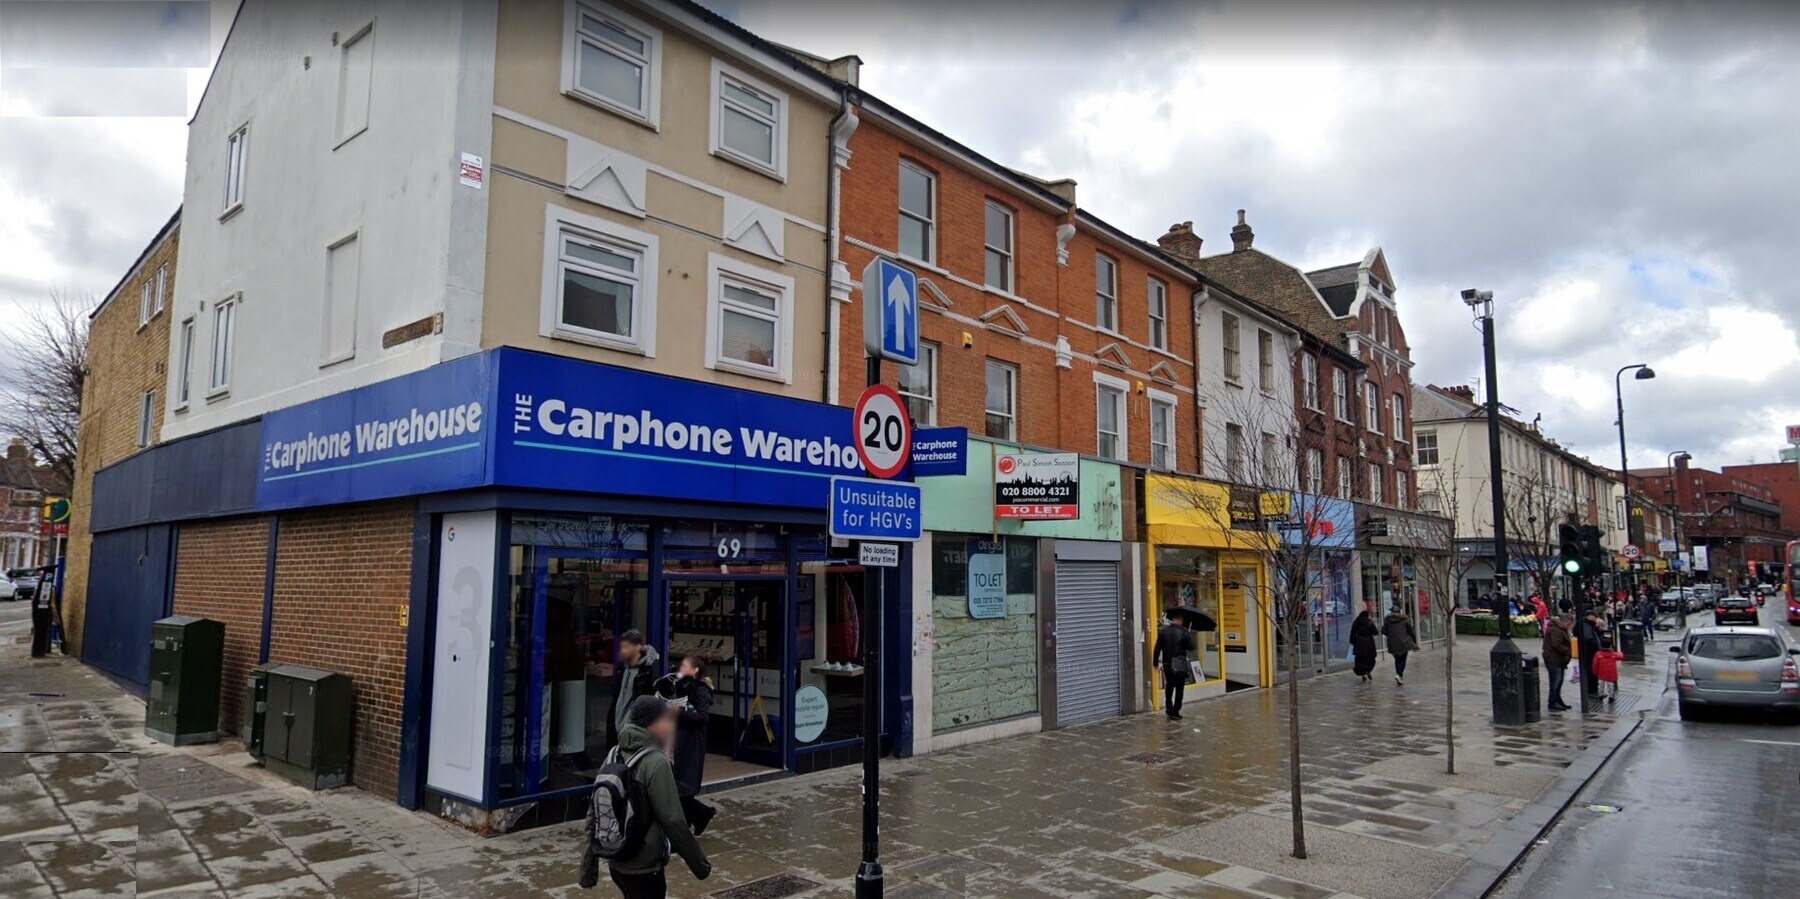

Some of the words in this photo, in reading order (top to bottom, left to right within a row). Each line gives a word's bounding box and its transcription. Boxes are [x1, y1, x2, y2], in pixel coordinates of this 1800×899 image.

[264, 443, 272, 473] THE
[272, 430, 351, 471] Carphone
[355, 402, 482, 454] Warehouse
[514, 393, 532, 433] THE
[538, 399, 733, 455] Carphone
[740, 427, 867, 471] Wareho
[864, 410, 901, 452] 20
[917, 440, 958, 451] Carphone
[912, 452, 958, 461] Warehouse
[1017, 459, 1030, 467] Paul
[1032, 459, 1052, 467] Simon
[840, 486, 916, 509] Unsuitable
[1002, 487, 1020, 496] 020
[1022, 487, 1046, 496] 8800
[1048, 486, 1070, 496] 4321
[1010, 506, 1030, 514] TO
[1034, 506, 1062, 514] LET
[843, 509, 864, 527] for
[870, 511, 912, 530] HGV's
[717, 538, 741, 558] 69
[863, 546, 873, 554] No
[874, 546, 896, 556] loading
[973, 573, 987, 587] TO
[988, 573, 1003, 587] LET
